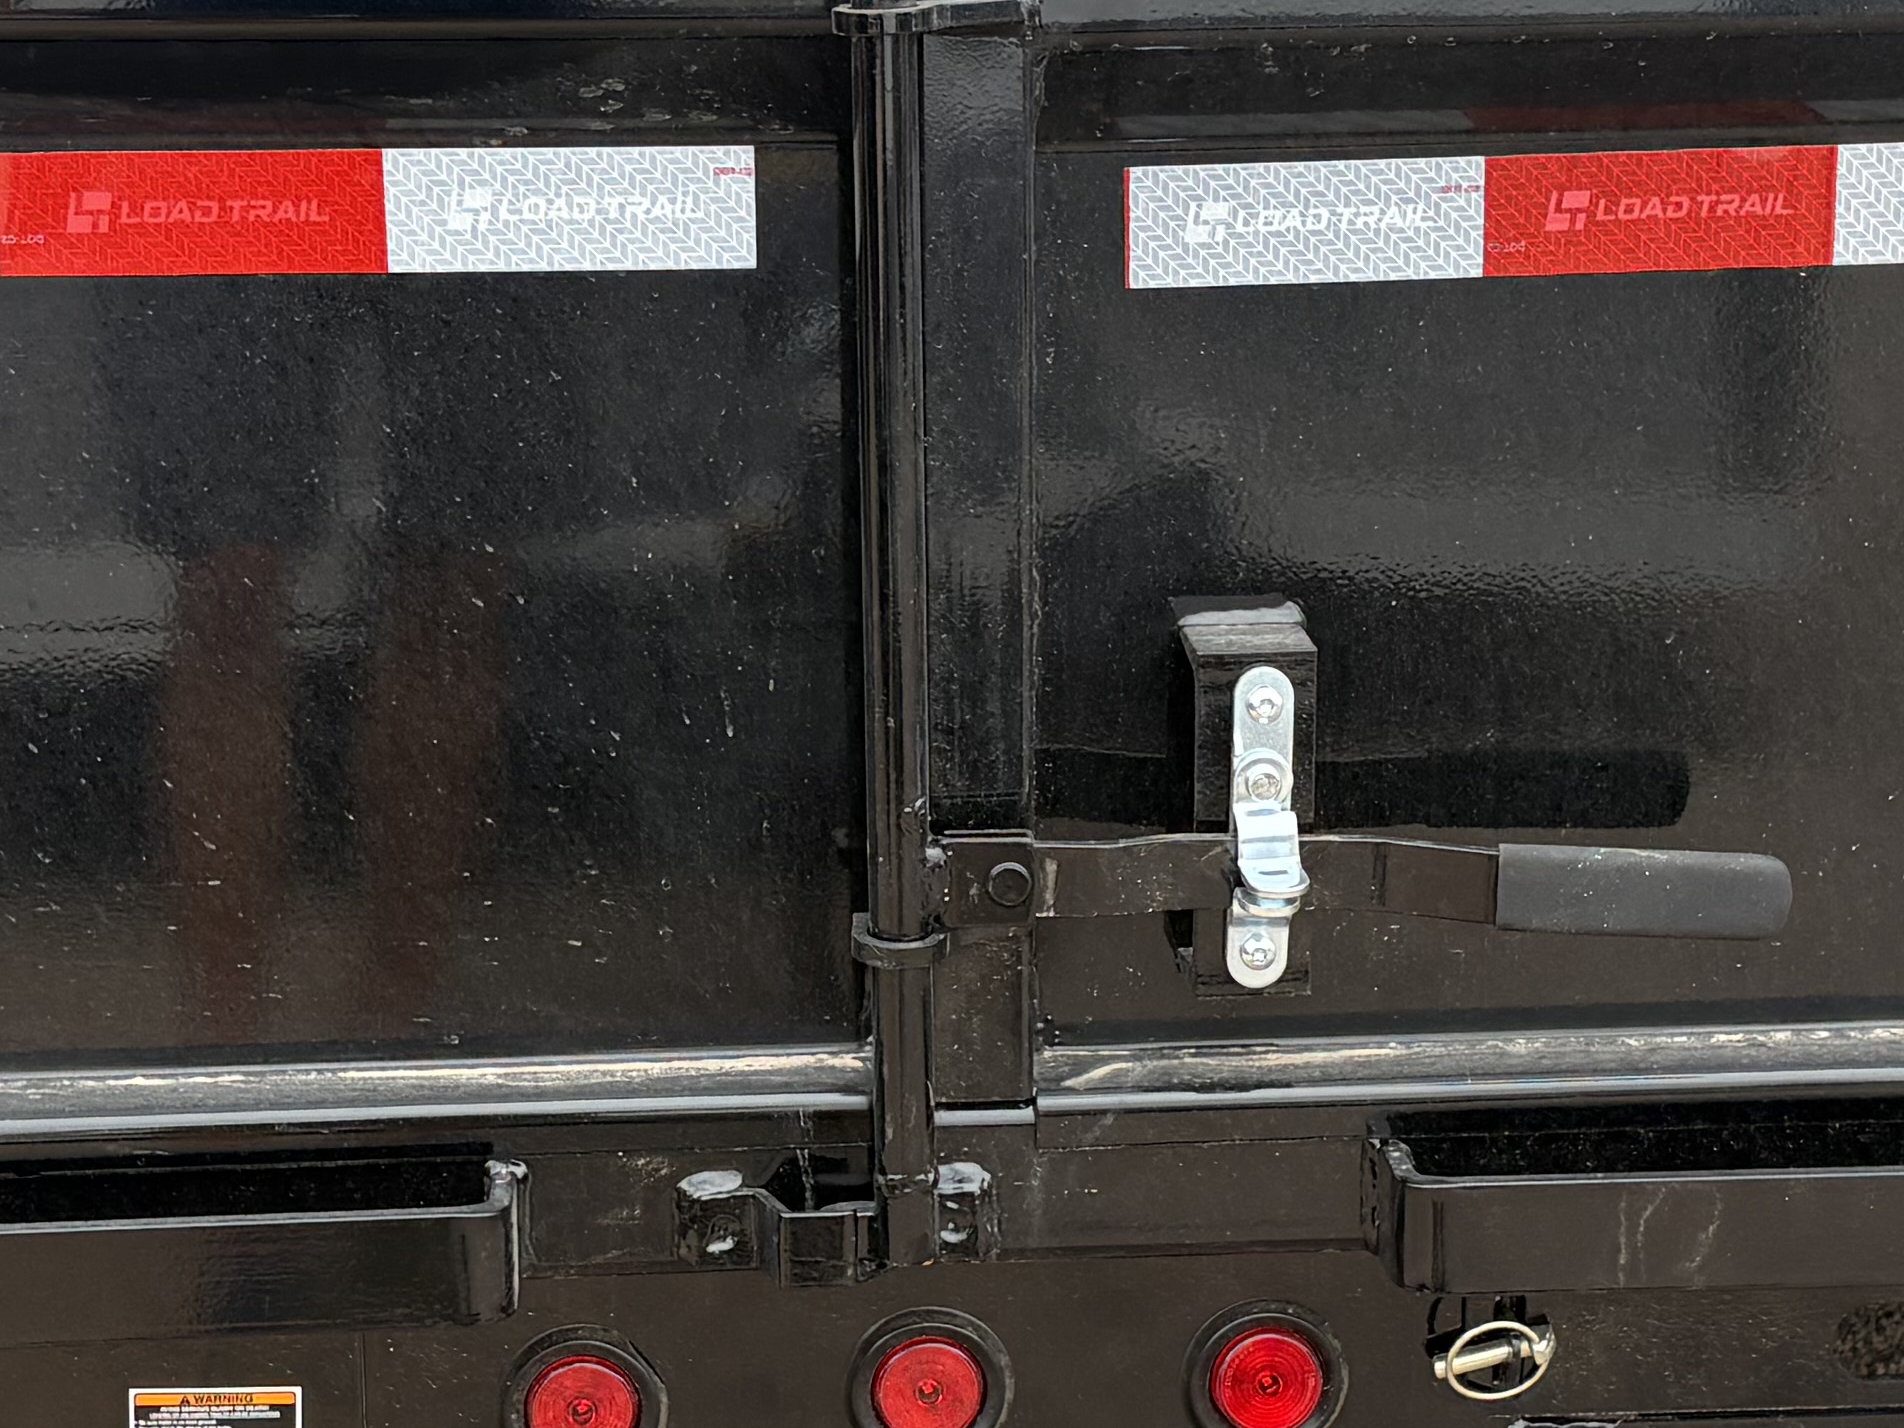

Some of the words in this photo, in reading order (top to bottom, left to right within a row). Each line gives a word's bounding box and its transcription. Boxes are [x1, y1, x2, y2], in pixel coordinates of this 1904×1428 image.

[121, 200, 218, 223] LOAD
[227, 199, 329, 222] TRAIL
[1596, 196, 1690, 221] LOAD
[1697, 193, 1795, 217] TRAIL
[194, 1395, 254, 1405] WARNING
